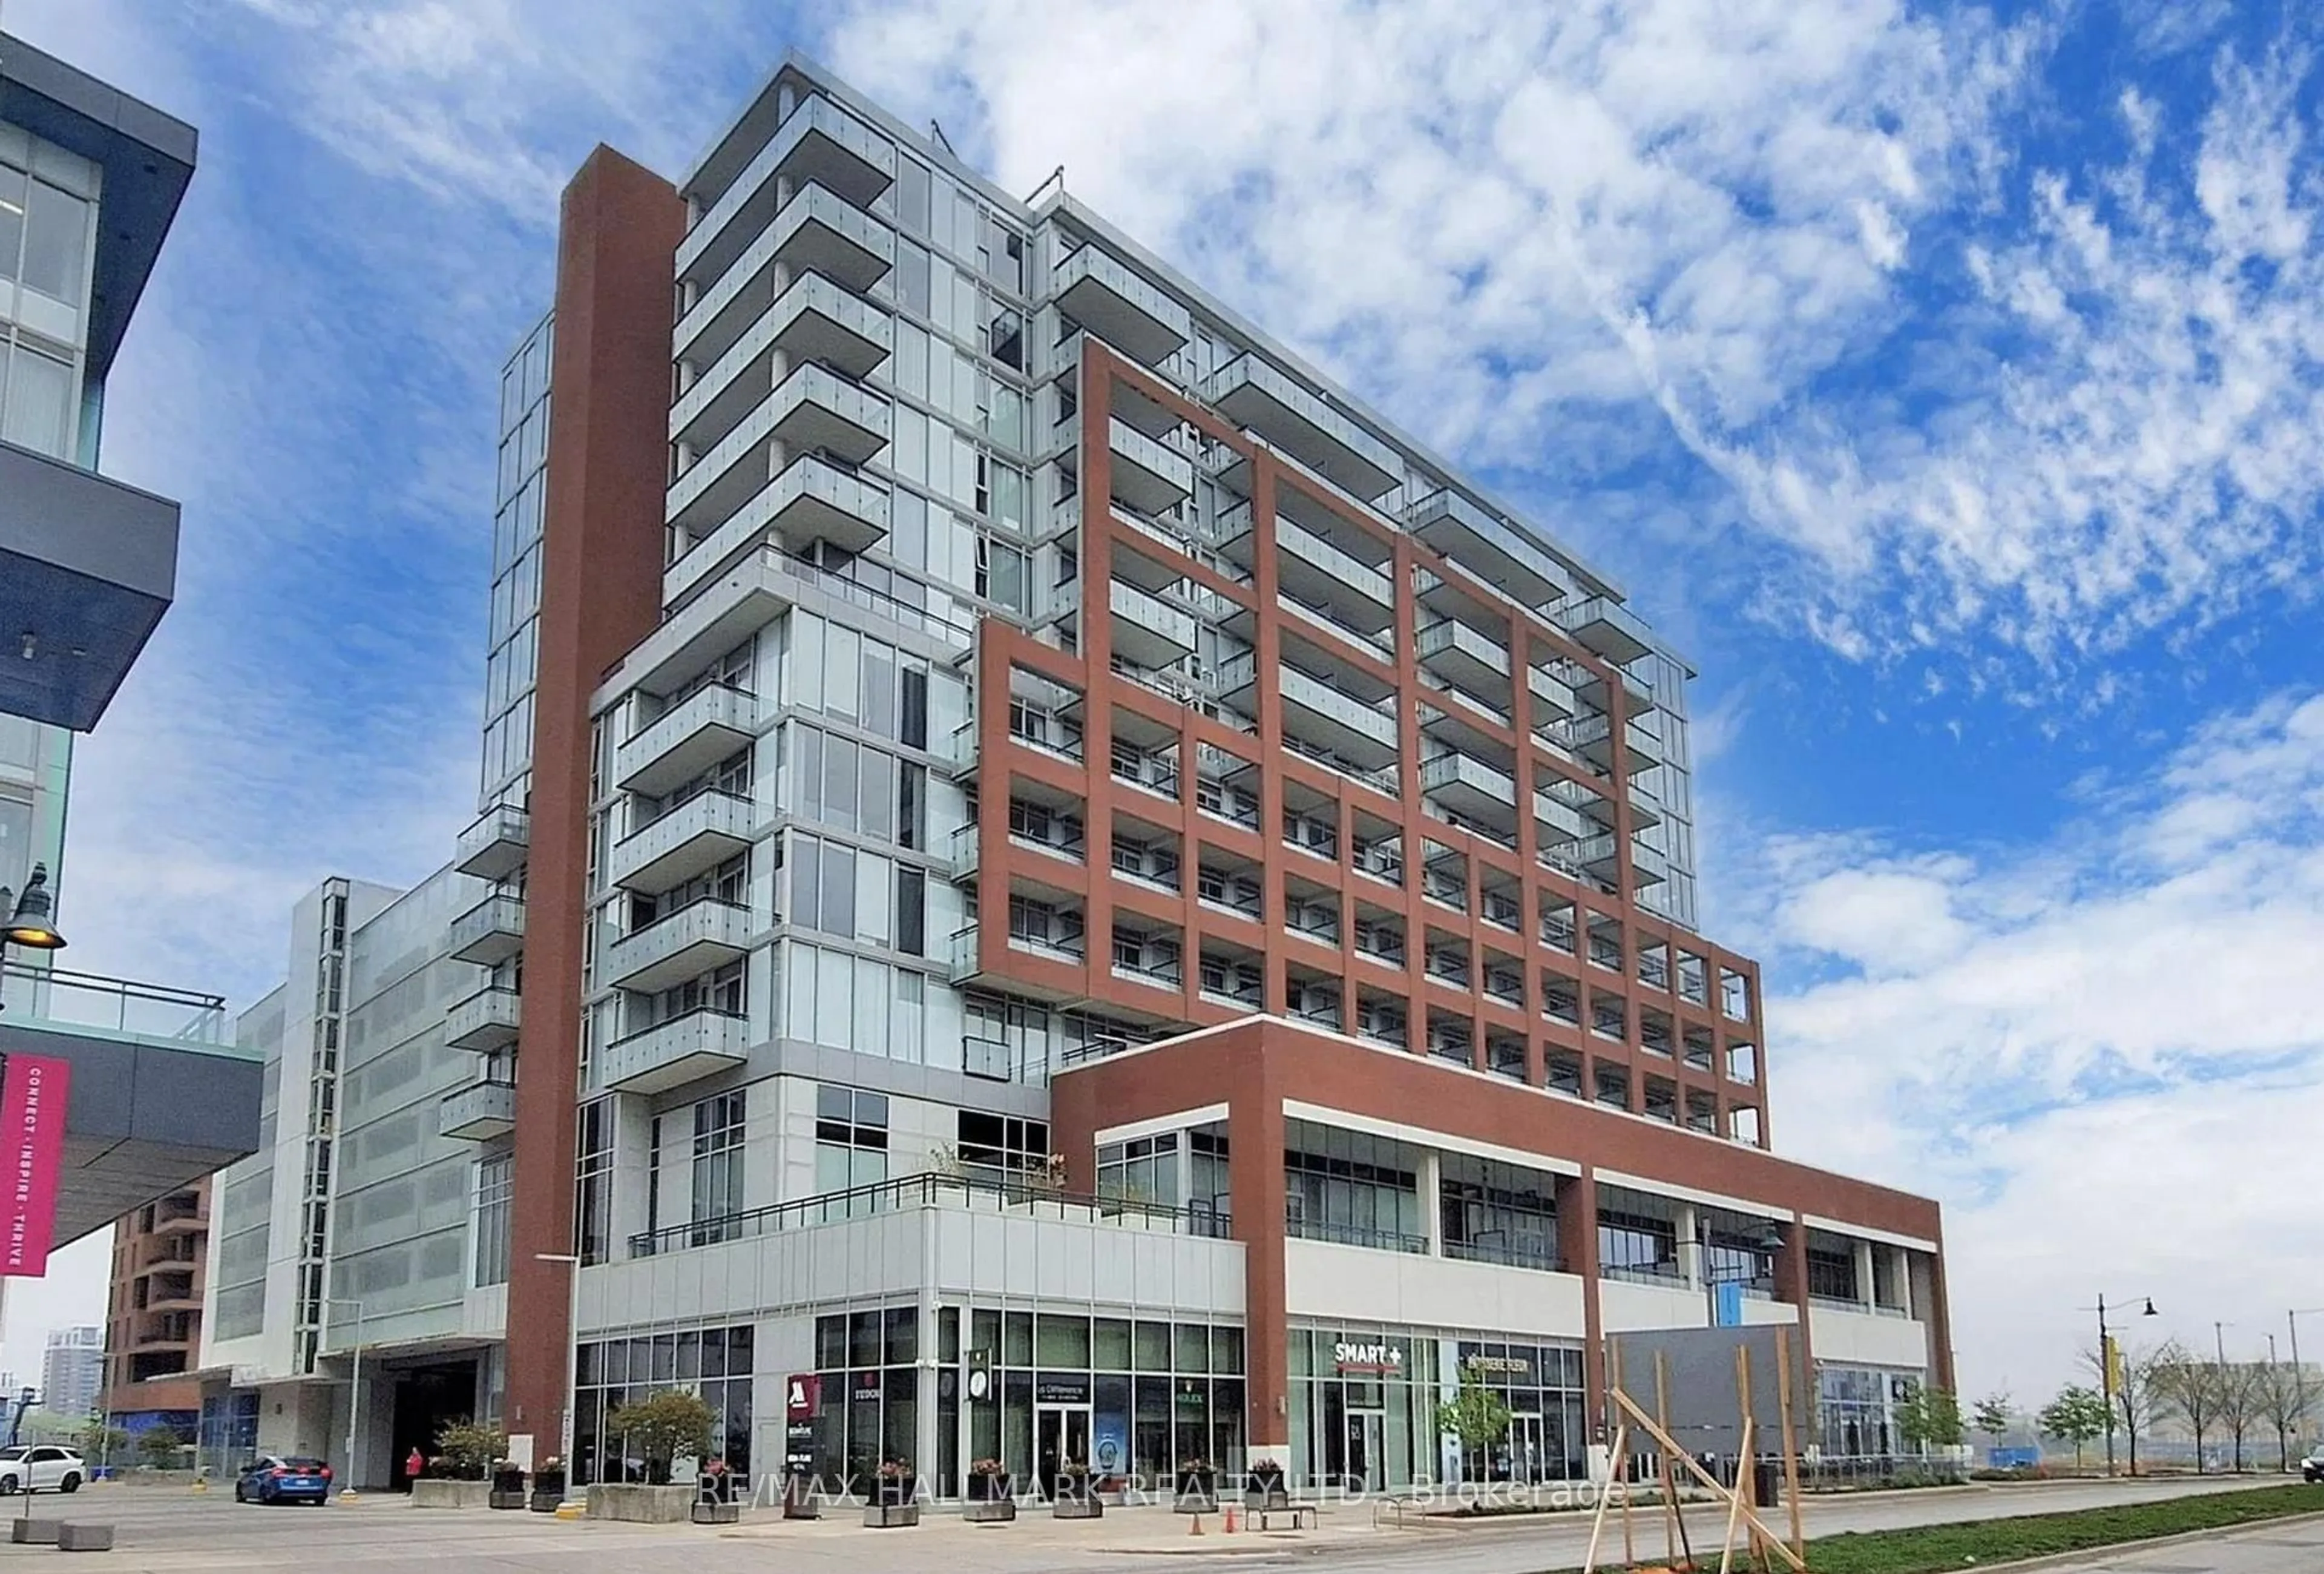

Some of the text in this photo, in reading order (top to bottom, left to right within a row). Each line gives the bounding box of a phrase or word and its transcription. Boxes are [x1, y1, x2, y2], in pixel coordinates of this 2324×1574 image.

[8, 1067, 42, 1266] CONNECT INSPIRE THRIVE
[1335, 1343, 1386, 1364] SMART
